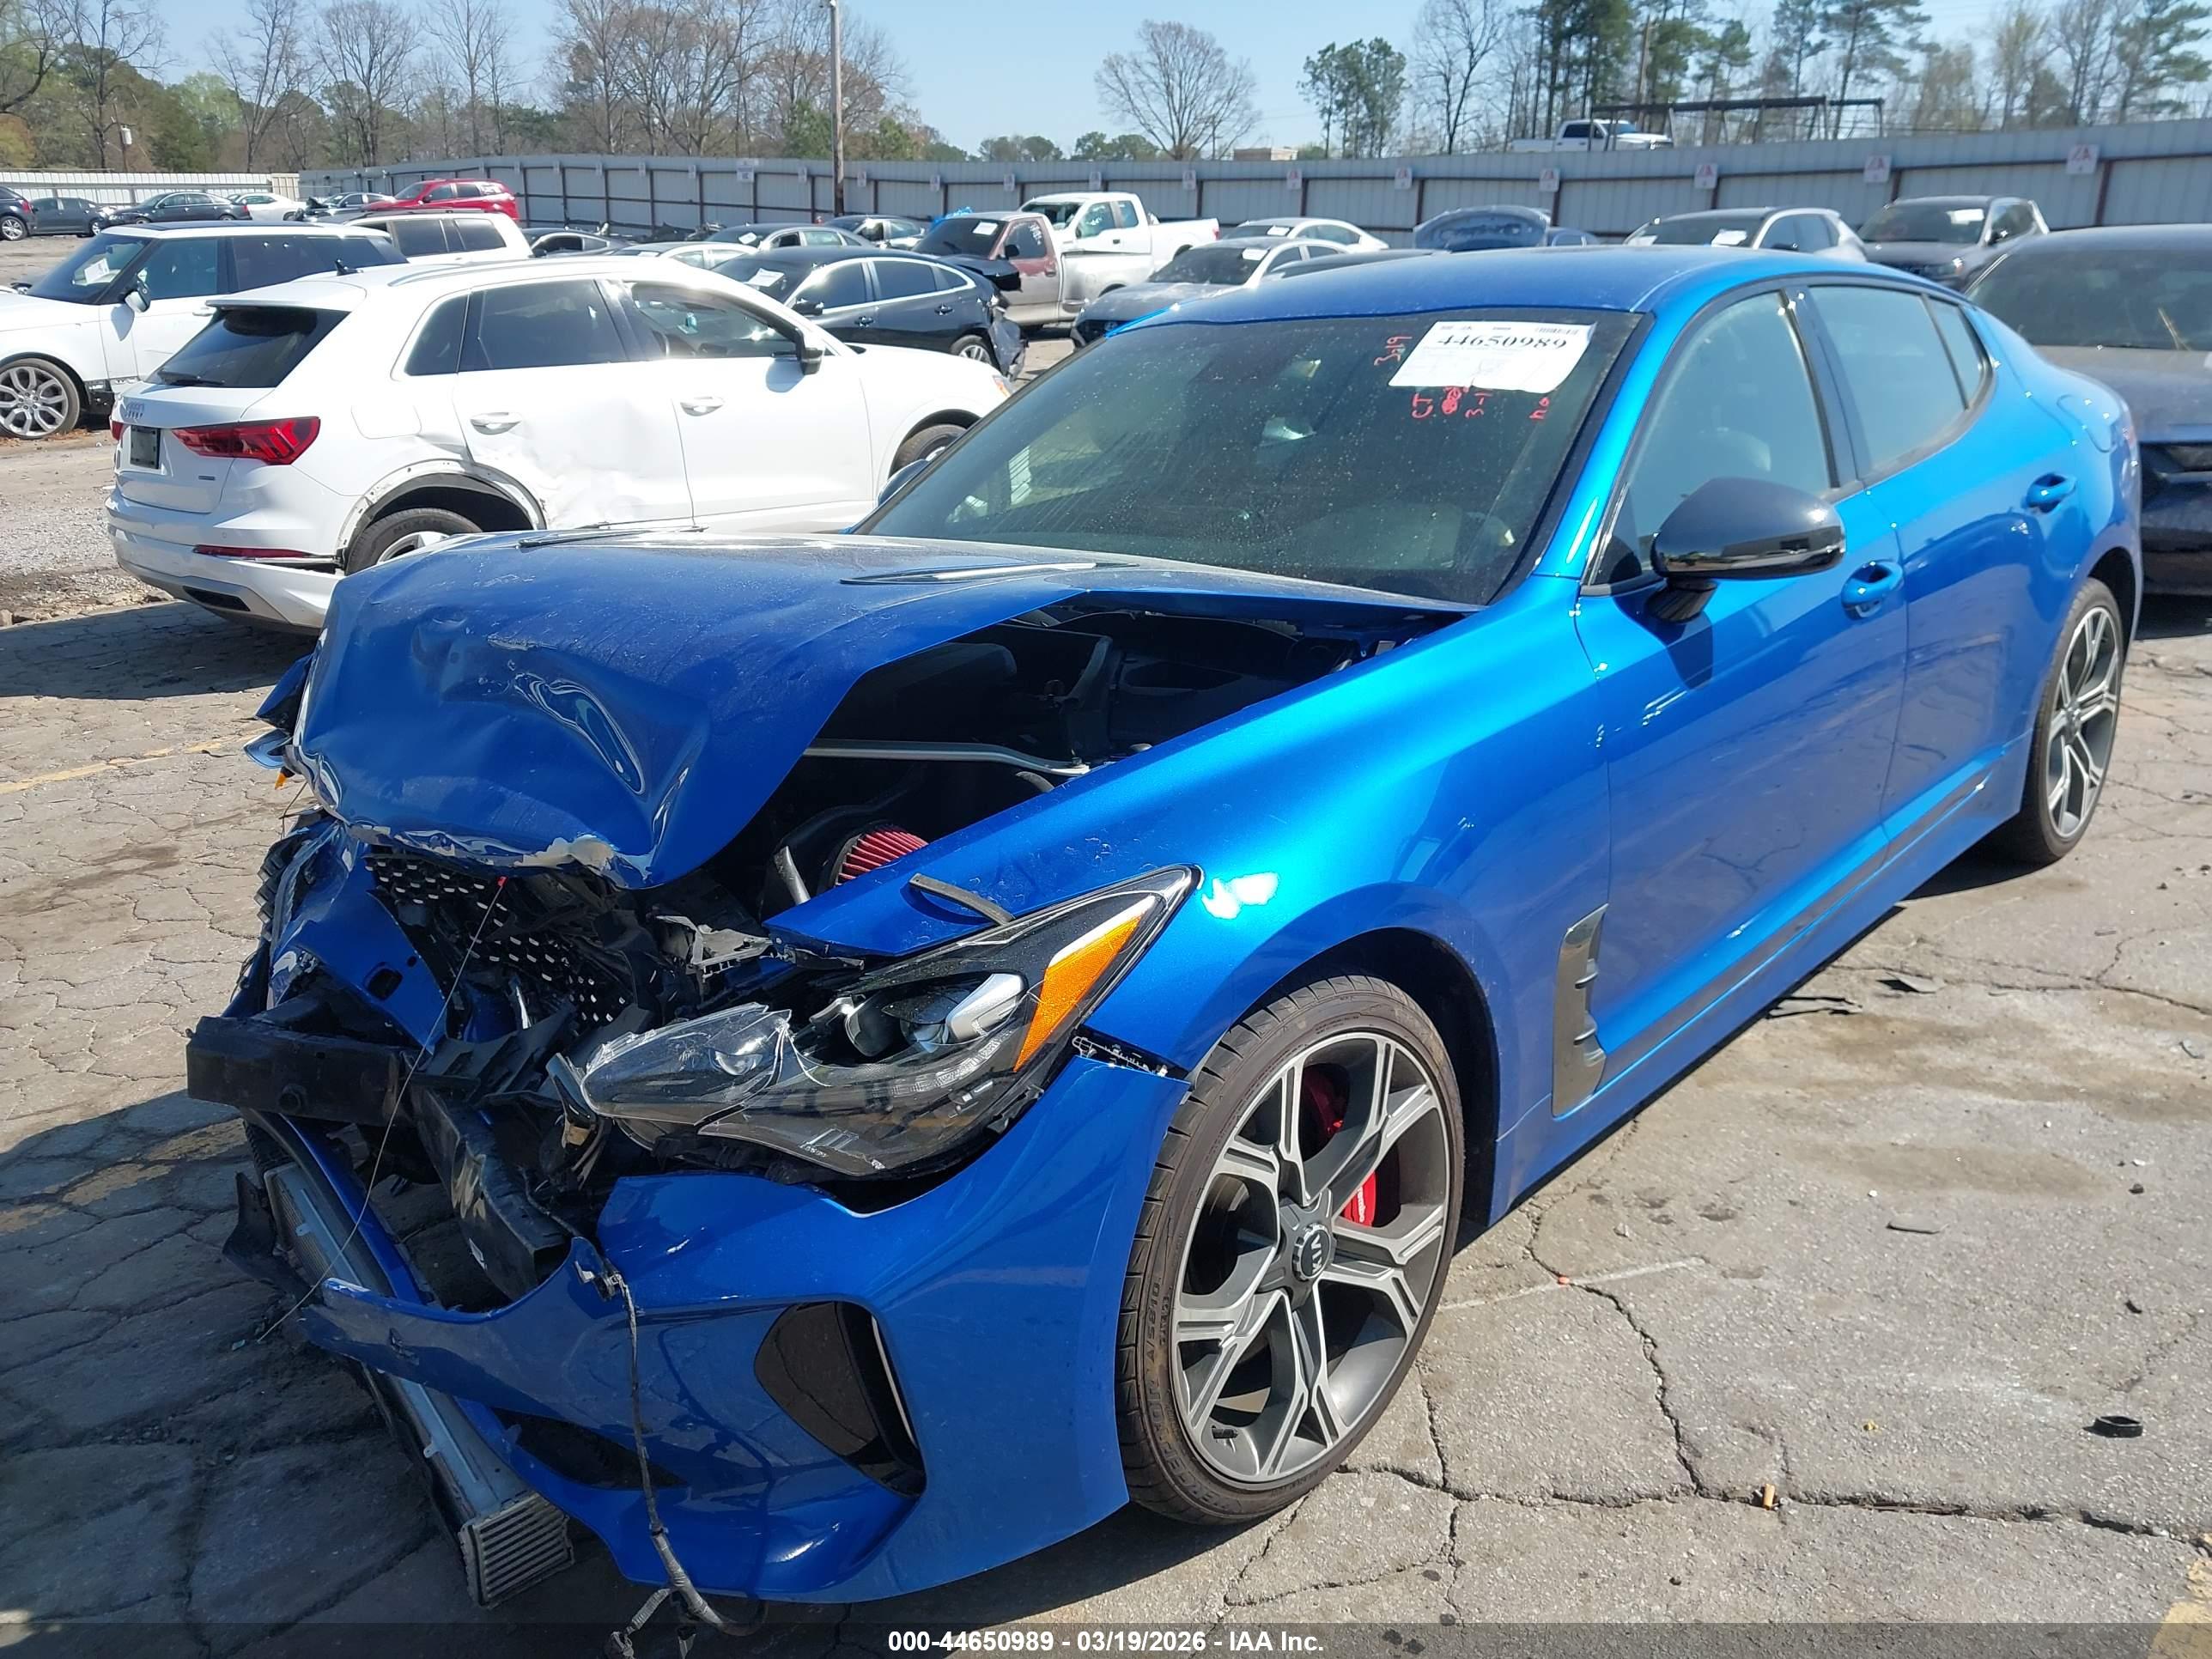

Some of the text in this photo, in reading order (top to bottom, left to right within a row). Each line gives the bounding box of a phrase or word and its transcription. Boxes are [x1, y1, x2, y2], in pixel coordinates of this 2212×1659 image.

[1437, 334, 1568, 349] 44650989
[1356, 1186, 1367, 1224] rembo
[1310, 1233, 1323, 1275] KIA
